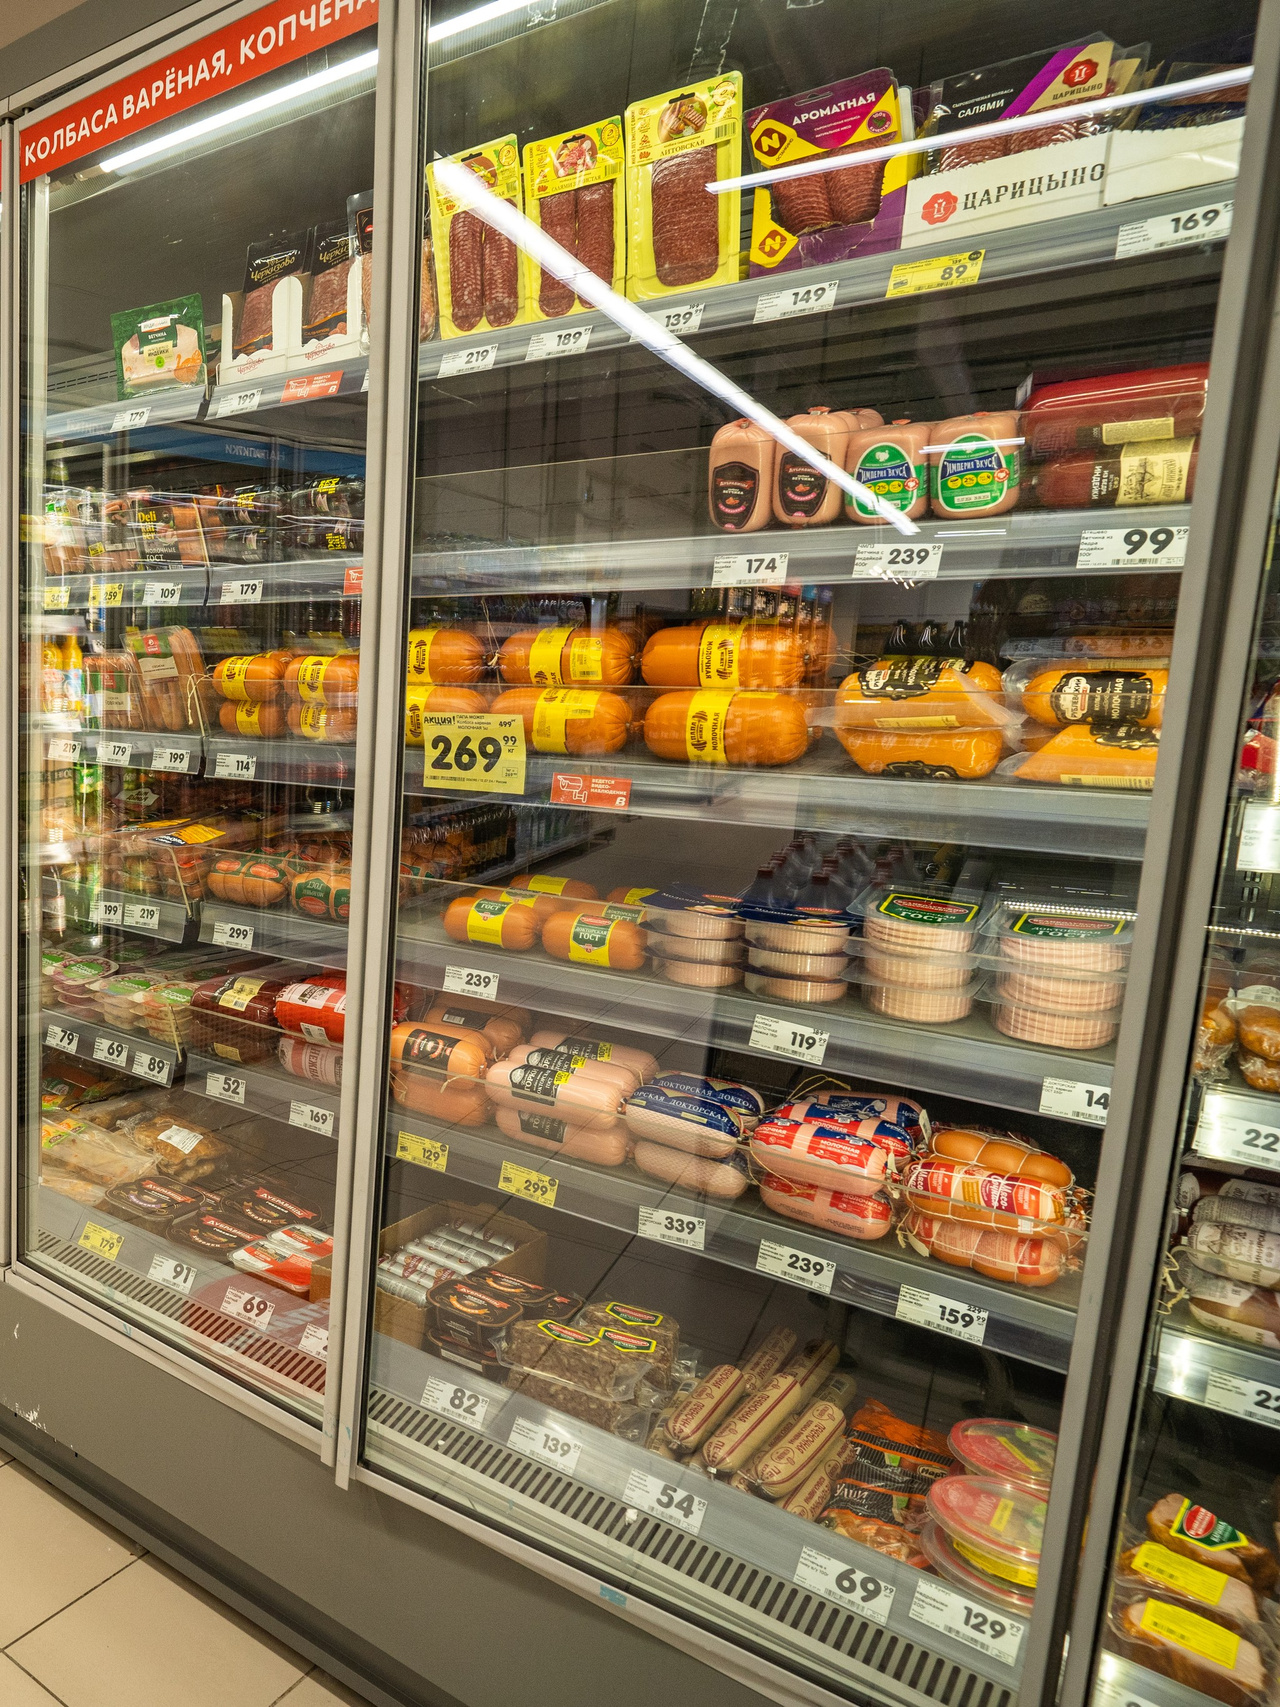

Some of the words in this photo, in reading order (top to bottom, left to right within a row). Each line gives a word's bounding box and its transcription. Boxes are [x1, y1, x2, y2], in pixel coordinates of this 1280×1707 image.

[1052, 82, 1103, 101] ЦАРИЦЫНО
[24, 103, 119, 166] КОЛБАСА
[122, 48, 234, 120] ВАРЁНАЯ,
[792, 91, 876, 126] АРОМАТНАЯ
[957, 98, 1005, 119] САЛЯМИ
[659, 138, 705, 157] ЛИТОВСКАЯ
[962, 162, 1105, 211] ЦАРИЦЫНО
[1170, 209, 1221, 234] 169
[250, 256, 296, 282] Черкизово
[940, 264, 968, 282] 89
[792, 286, 827, 306] 149
[665, 310, 692, 329] 139
[556, 330, 582, 347] 189
[465, 349, 490, 364] 219
[237, 393, 256, 406] 199
[129, 410, 145, 423] 179
[138, 511, 156, 523] Deli
[1124, 528, 1174, 555] 99
[146, 553, 164, 562] ГОСТ
[888, 548, 929, 565] 239
[746, 558, 777, 574] 174
[103, 590, 118, 600] 259
[160, 587, 175, 599] 109
[239, 584, 257, 595] 179
[705, 640, 713, 680] МОЛОЧНАЯ
[424, 716, 456, 725] АКЦИЯ!
[712, 712, 720, 751] МОЛОЧНАЯ
[63, 743, 76, 754] 219
[112, 745, 127, 756] 179
[431, 735, 502, 772] 269
[503, 736, 517, 745] 99
[169, 752, 185, 764] 199
[235, 759, 250, 772] 114
[615, 797, 626, 806] В
[104, 904, 118, 915] 199
[139, 908, 155, 920] 219
[481, 902, 500, 912] ГОСТ
[229, 927, 248, 940] 299
[579, 931, 601, 942] ГОСТ
[465, 972, 491, 988] 239
[60, 1030, 75, 1044] 79
[790, 1031, 816, 1050] 119
[107, 1043, 124, 1057] 69
[147, 1058, 165, 1074] 89
[222, 1077, 241, 1093] 52
[658, 1079, 713, 1097] ДОКТОРСКАЯ
[309, 1109, 328, 1123] 169
[669, 1100, 728, 1123] ДОКТОРСКАЯ
[811, 1119, 849, 1134] МОЛОЧНАЯ
[421, 1148, 440, 1162] 129
[819, 1138, 861, 1155] МОЛОЧНАЯ
[524, 1180, 549, 1196] 299
[664, 1215, 698, 1236] 339
[99, 1237, 115, 1251] 179
[172, 1263, 190, 1283] 91
[787, 1253, 825, 1278] 239
[243, 1296, 268, 1317] 69
[938, 1305, 973, 1328] 159
[449, 1387, 479, 1417] 82
[542, 1433, 571, 1458] 139
[655, 1488, 696, 1519] 54
[835, 1568, 882, 1603] 69
[883, 1586, 895, 1594] 99
[963, 1606, 1007, 1639] 129
